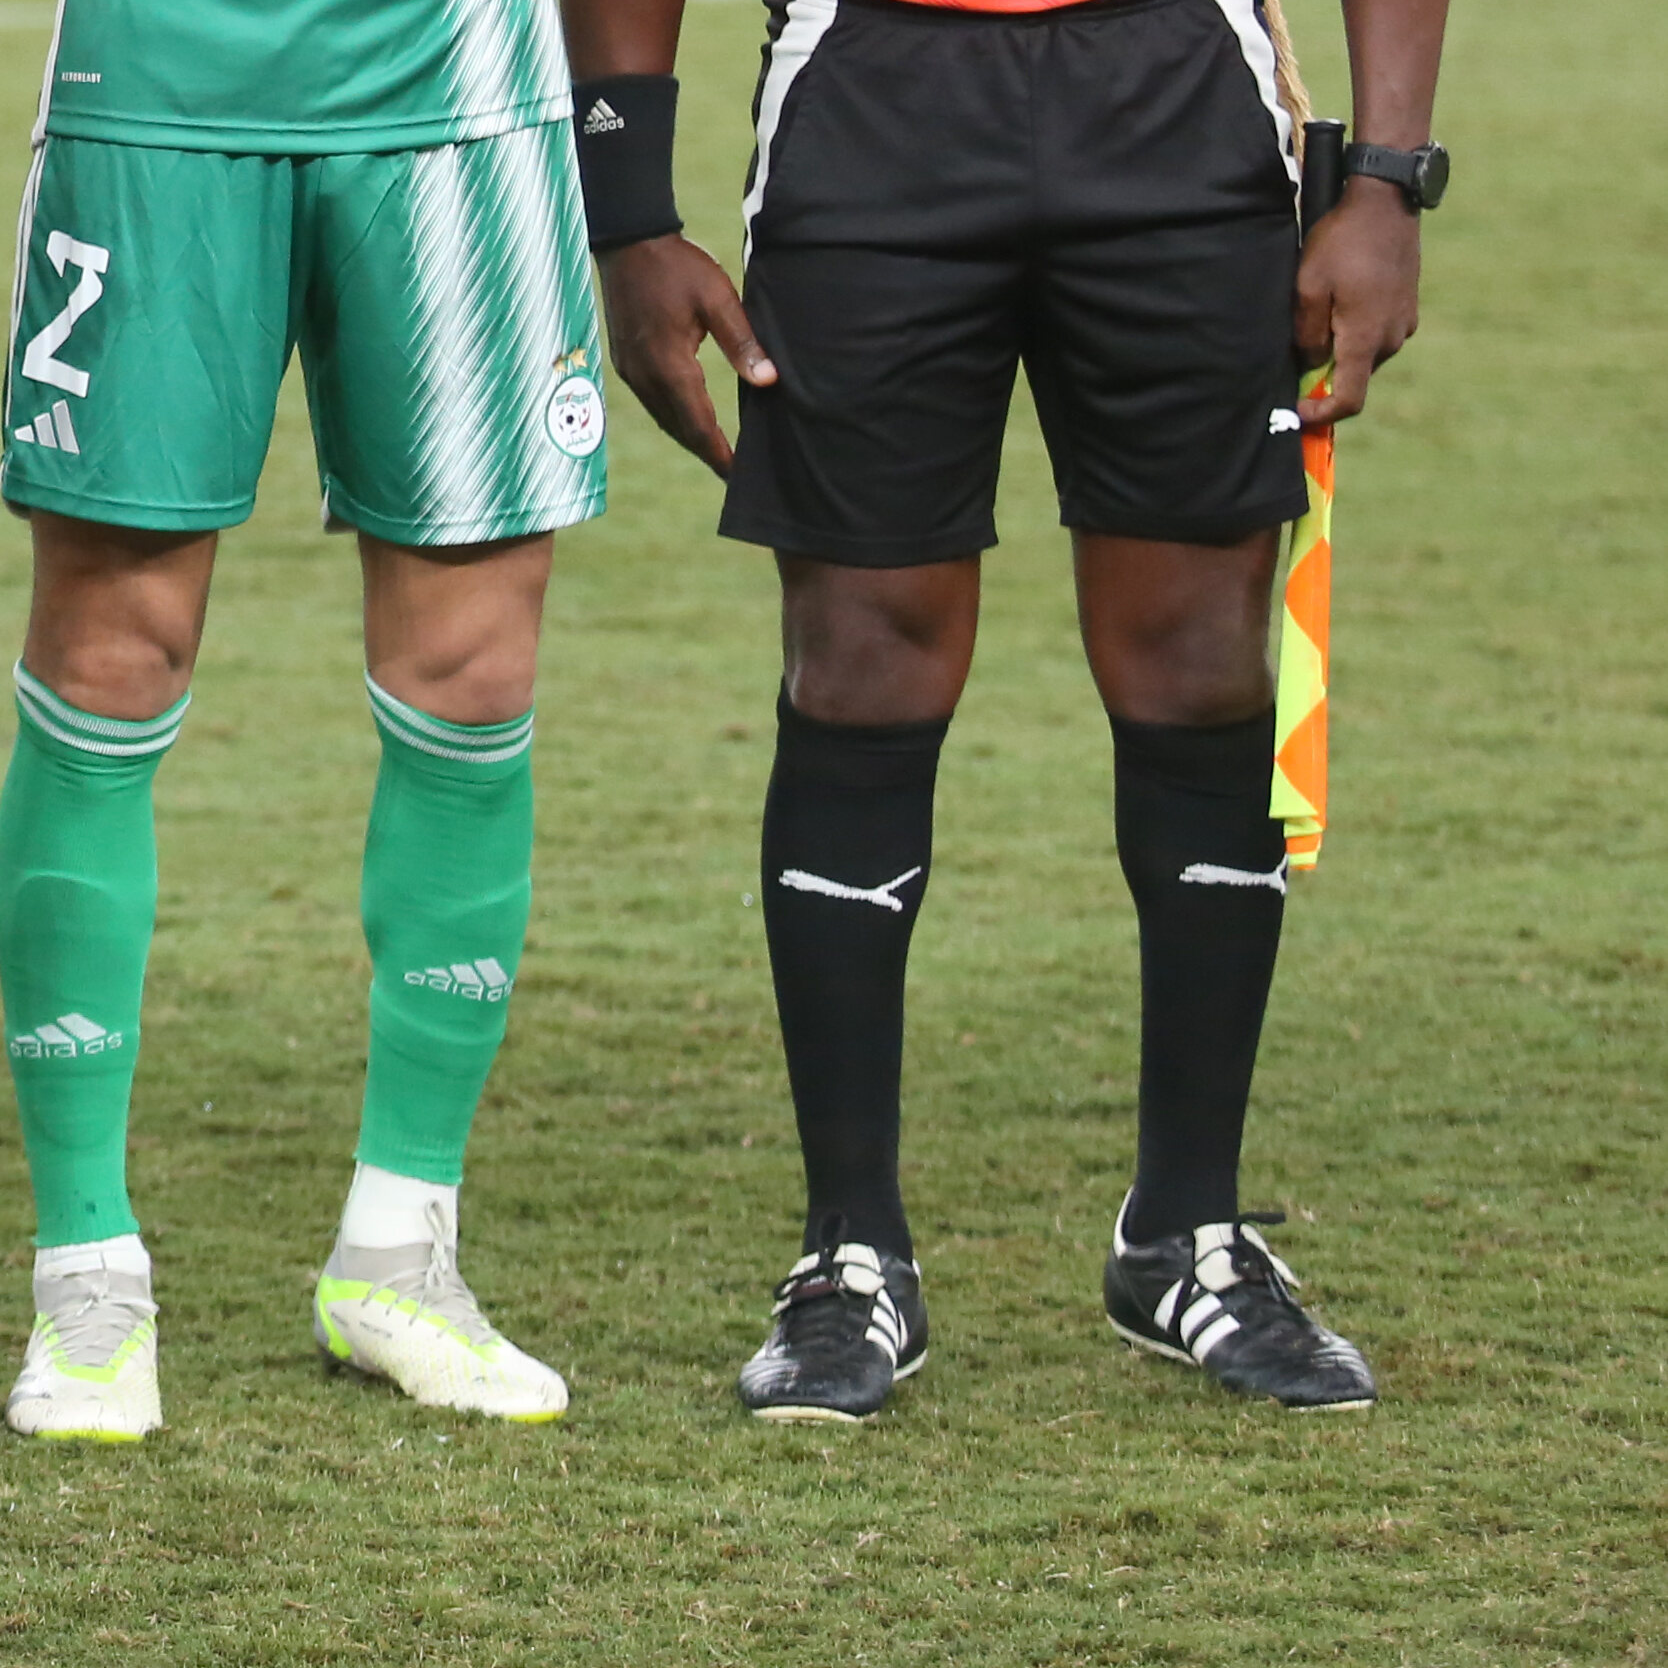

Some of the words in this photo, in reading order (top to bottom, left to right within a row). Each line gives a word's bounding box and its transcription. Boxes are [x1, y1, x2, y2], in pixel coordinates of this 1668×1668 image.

[583, 116, 625, 135] adidas
[21, 230, 110, 398] 2
[9, 1032, 123, 1059] adidas
